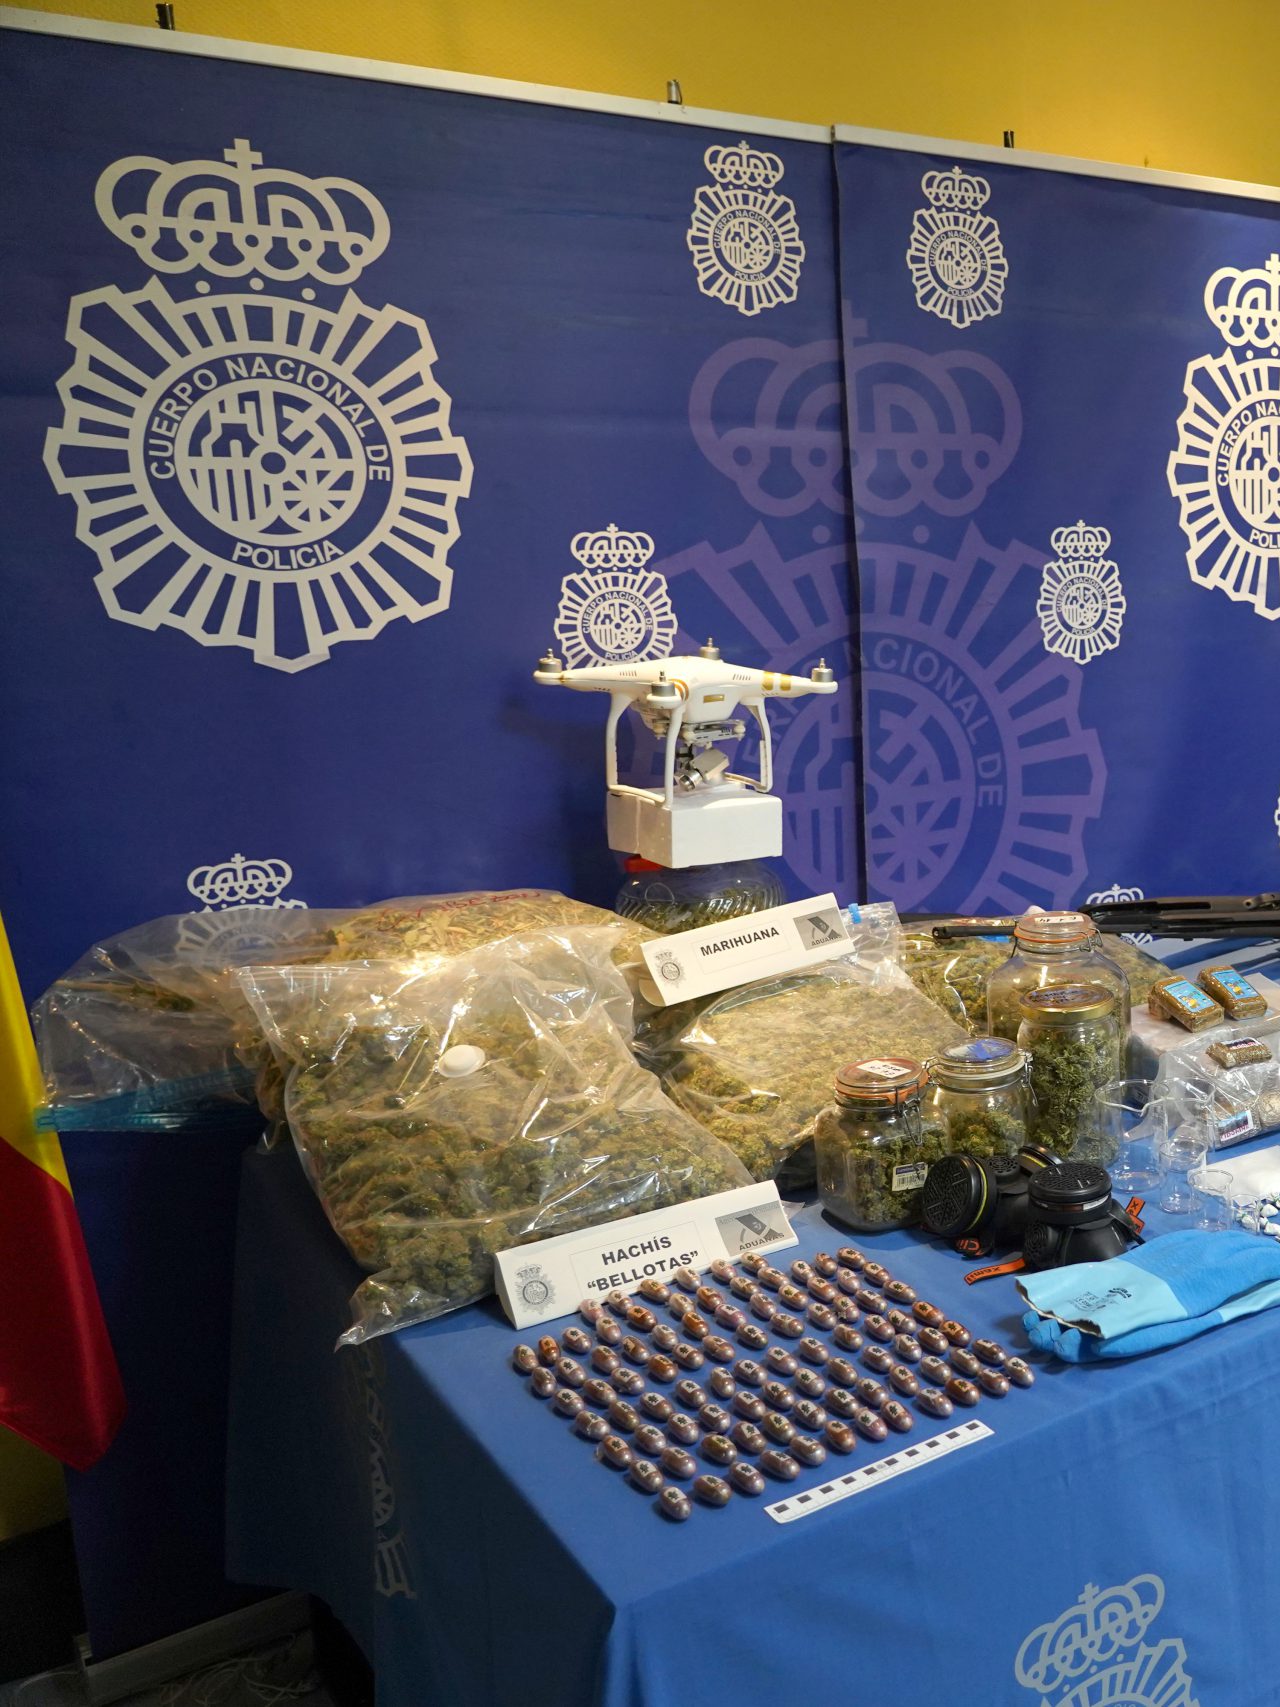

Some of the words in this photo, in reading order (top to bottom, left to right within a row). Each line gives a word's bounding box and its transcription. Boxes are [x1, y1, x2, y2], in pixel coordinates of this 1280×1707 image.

[714, 213, 734, 248] CUERPO
[735, 210, 777, 239] NACIONAL
[773, 241, 781, 254] DE
[929, 233, 947, 267] CUERPO
[948, 231, 984, 255] NACIONAL
[734, 270, 766, 281] POLICIA
[947, 287, 975, 297] POLICIA
[149, 369, 218, 480] CUERPO
[224, 356, 375, 438] NACIONAL
[365, 444, 391, 482] DE
[1217, 409, 1253, 487] CUERPO
[231, 540, 345, 570] POLICIA
[582, 597, 604, 634] CUERPO
[604, 592, 650, 616] NACIONAL
[645, 617, 654, 631] DE
[604, 650, 639, 661] POLICIA
[976, 752, 1003, 807] DE
[699, 926, 780, 957] MARIHUANA
[601, 1236, 672, 1266] HACHÍS
[739, 1232, 785, 1251] ADUANAS
